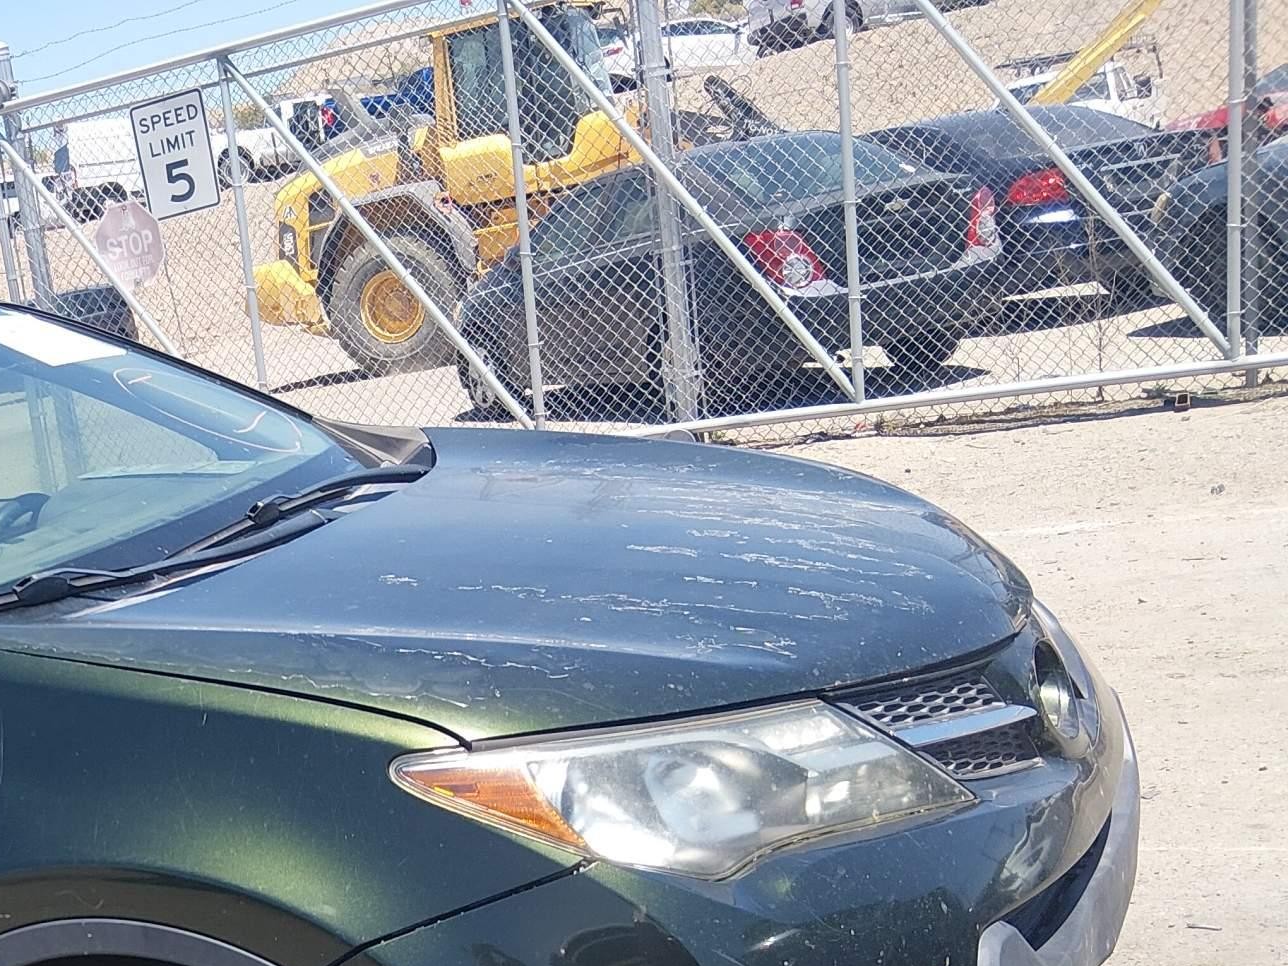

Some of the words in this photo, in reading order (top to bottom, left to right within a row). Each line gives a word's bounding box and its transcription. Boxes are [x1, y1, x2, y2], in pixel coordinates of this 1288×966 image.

[139, 104, 198, 134] SPEED
[149, 130, 195, 158] LIMIT
[165, 158, 195, 202] 5
[106, 230, 153, 260] STOP
